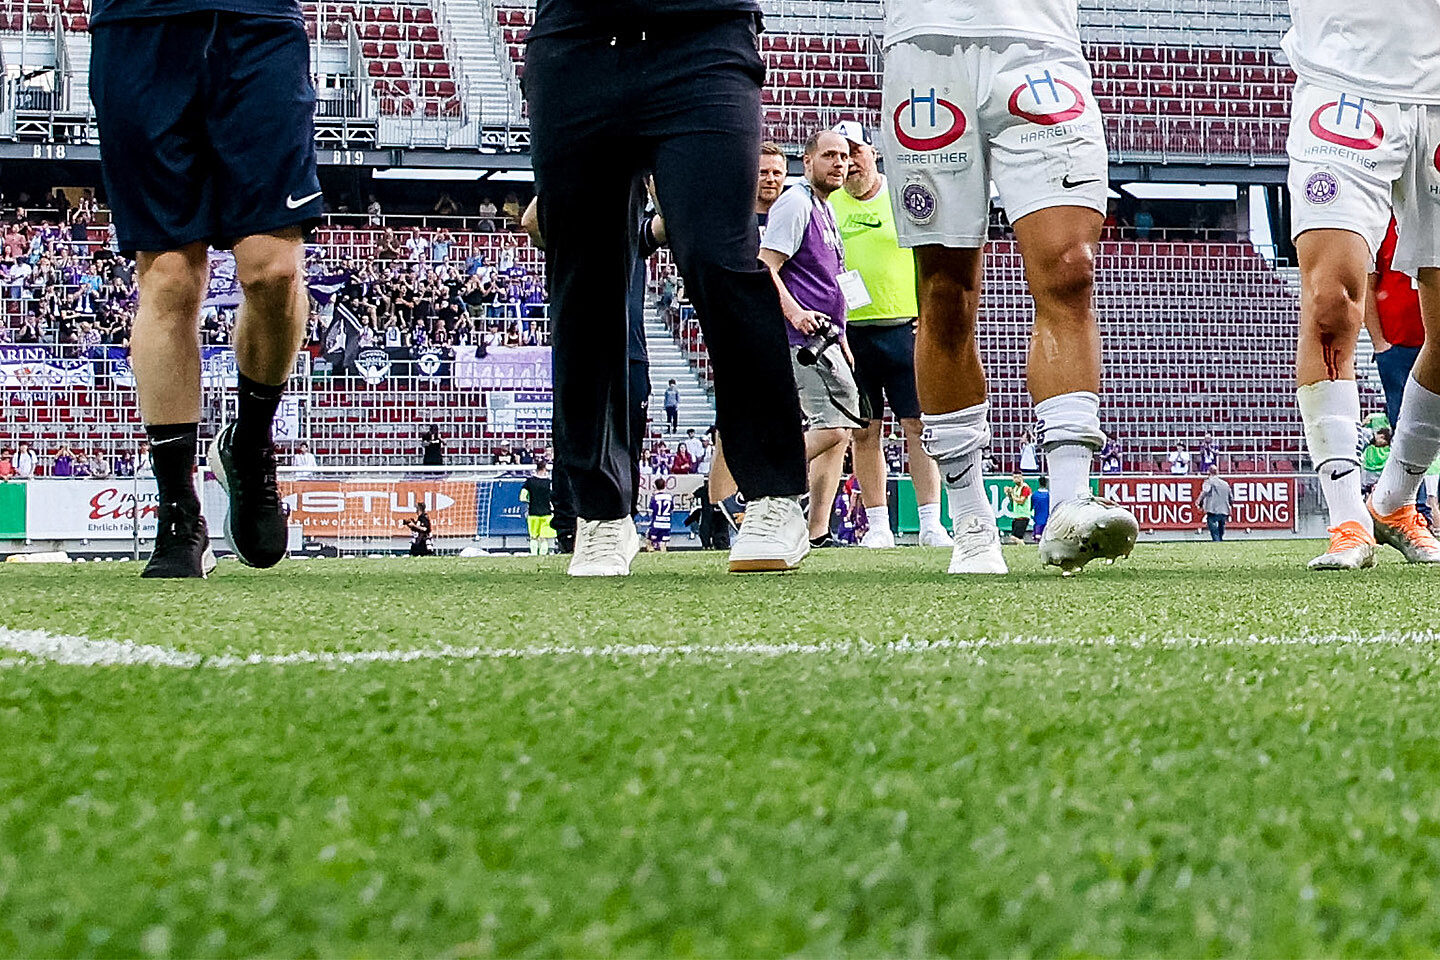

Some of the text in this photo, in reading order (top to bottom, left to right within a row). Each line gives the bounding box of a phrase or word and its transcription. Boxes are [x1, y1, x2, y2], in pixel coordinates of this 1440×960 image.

[33, 144, 66, 160] B18
[333, 150, 365, 166] B19
[1104, 483, 1193, 503] KLEINE
[1233, 482, 1289, 502] EINE
[656, 500, 671, 516] 12
[1125, 503, 1193, 523] ITUNG
